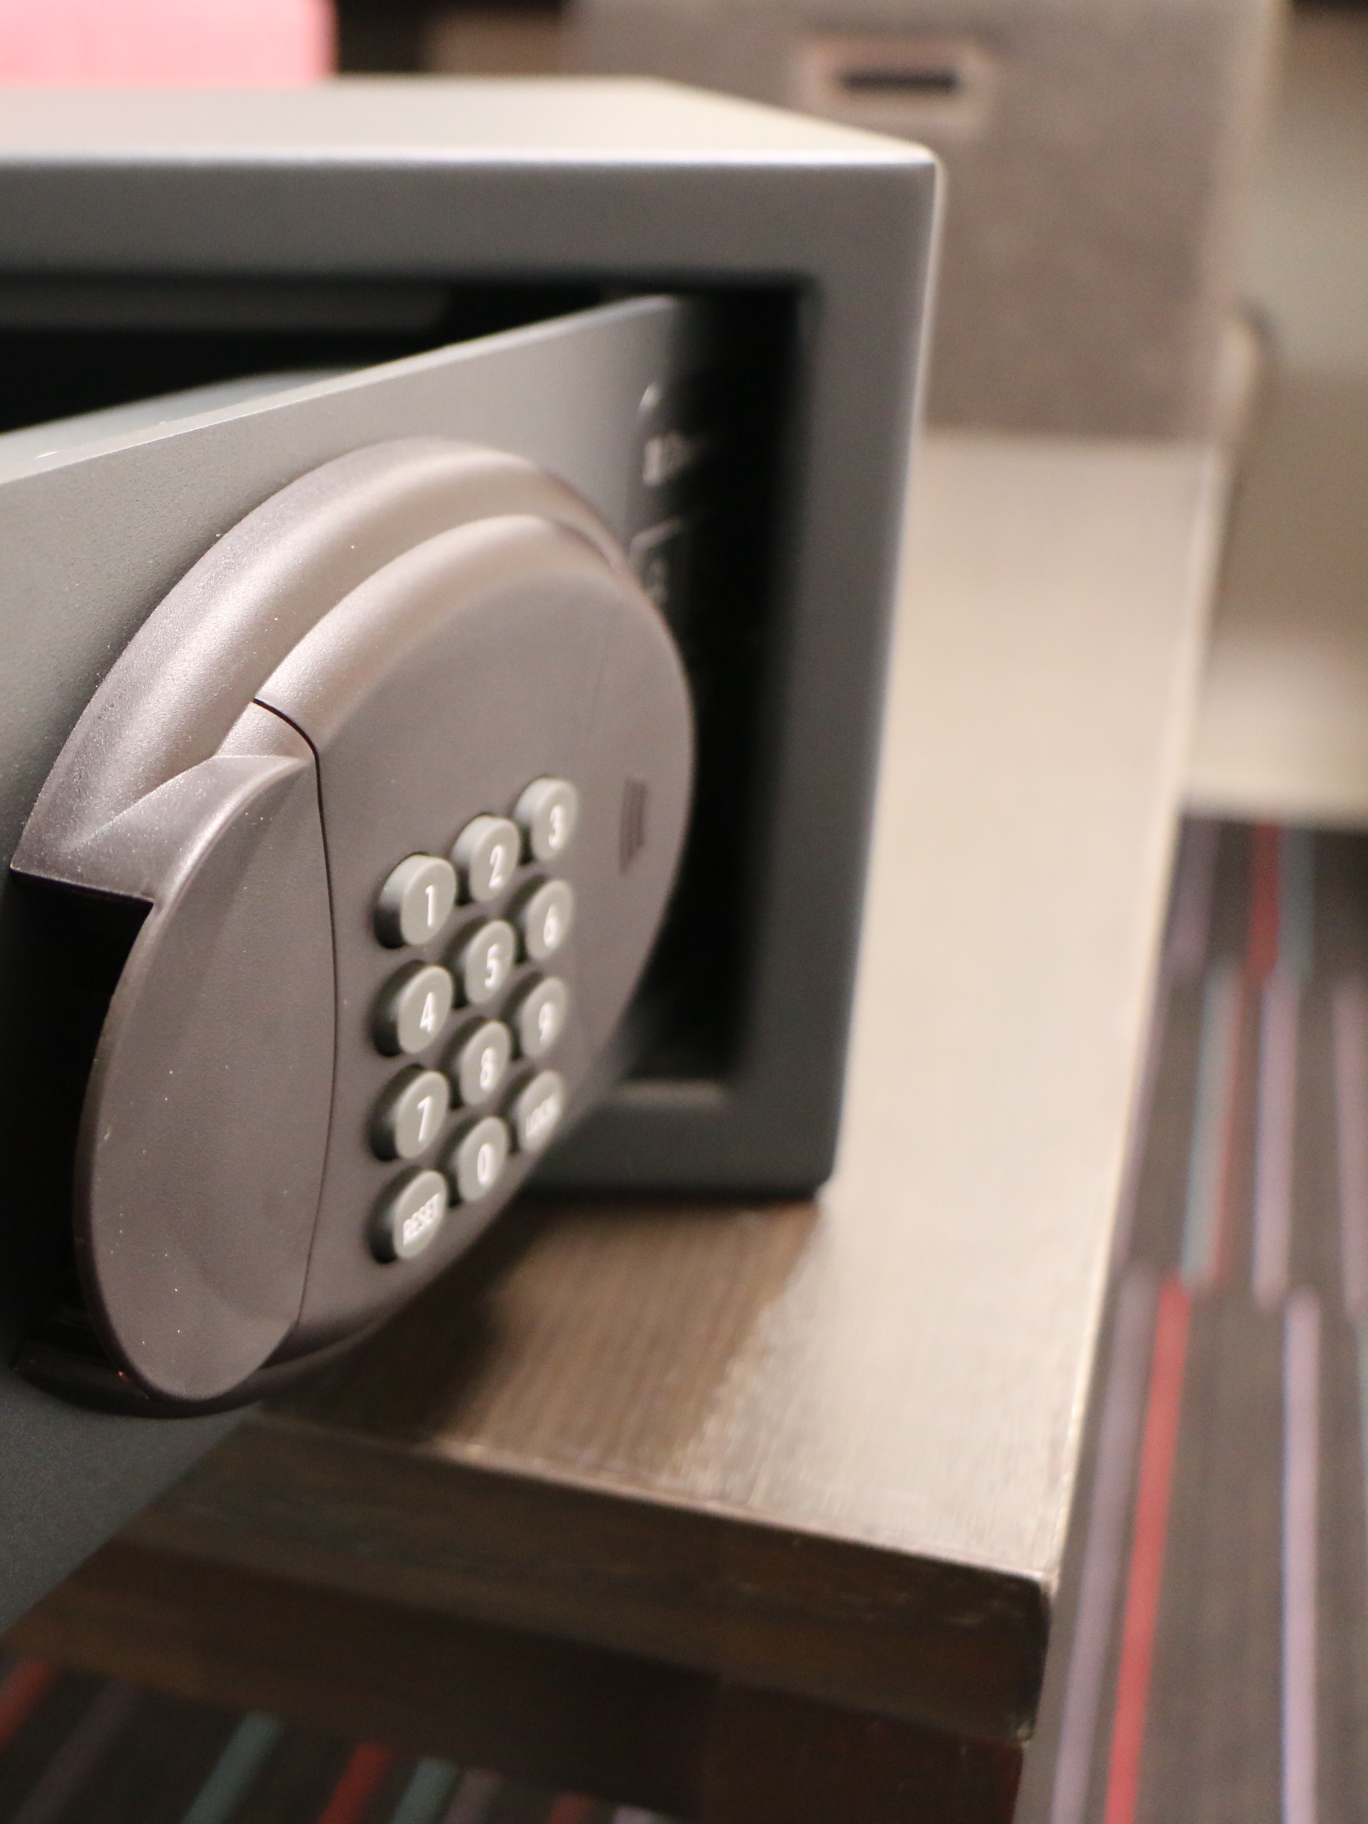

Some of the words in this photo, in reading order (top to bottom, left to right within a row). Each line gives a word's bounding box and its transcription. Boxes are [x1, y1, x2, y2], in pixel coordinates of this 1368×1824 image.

[548, 805, 564, 850] 3
[489, 844, 505, 889] 2
[425, 884, 436, 928] 1
[543, 905, 560, 950] 6
[485, 944, 501, 988] 5
[419, 992, 436, 1034] 4
[538, 1002, 554, 1042] 9
[480, 1047, 496, 1091] 8
[417, 1095, 433, 1142] 7
[477, 1142, 493, 1188] 0
